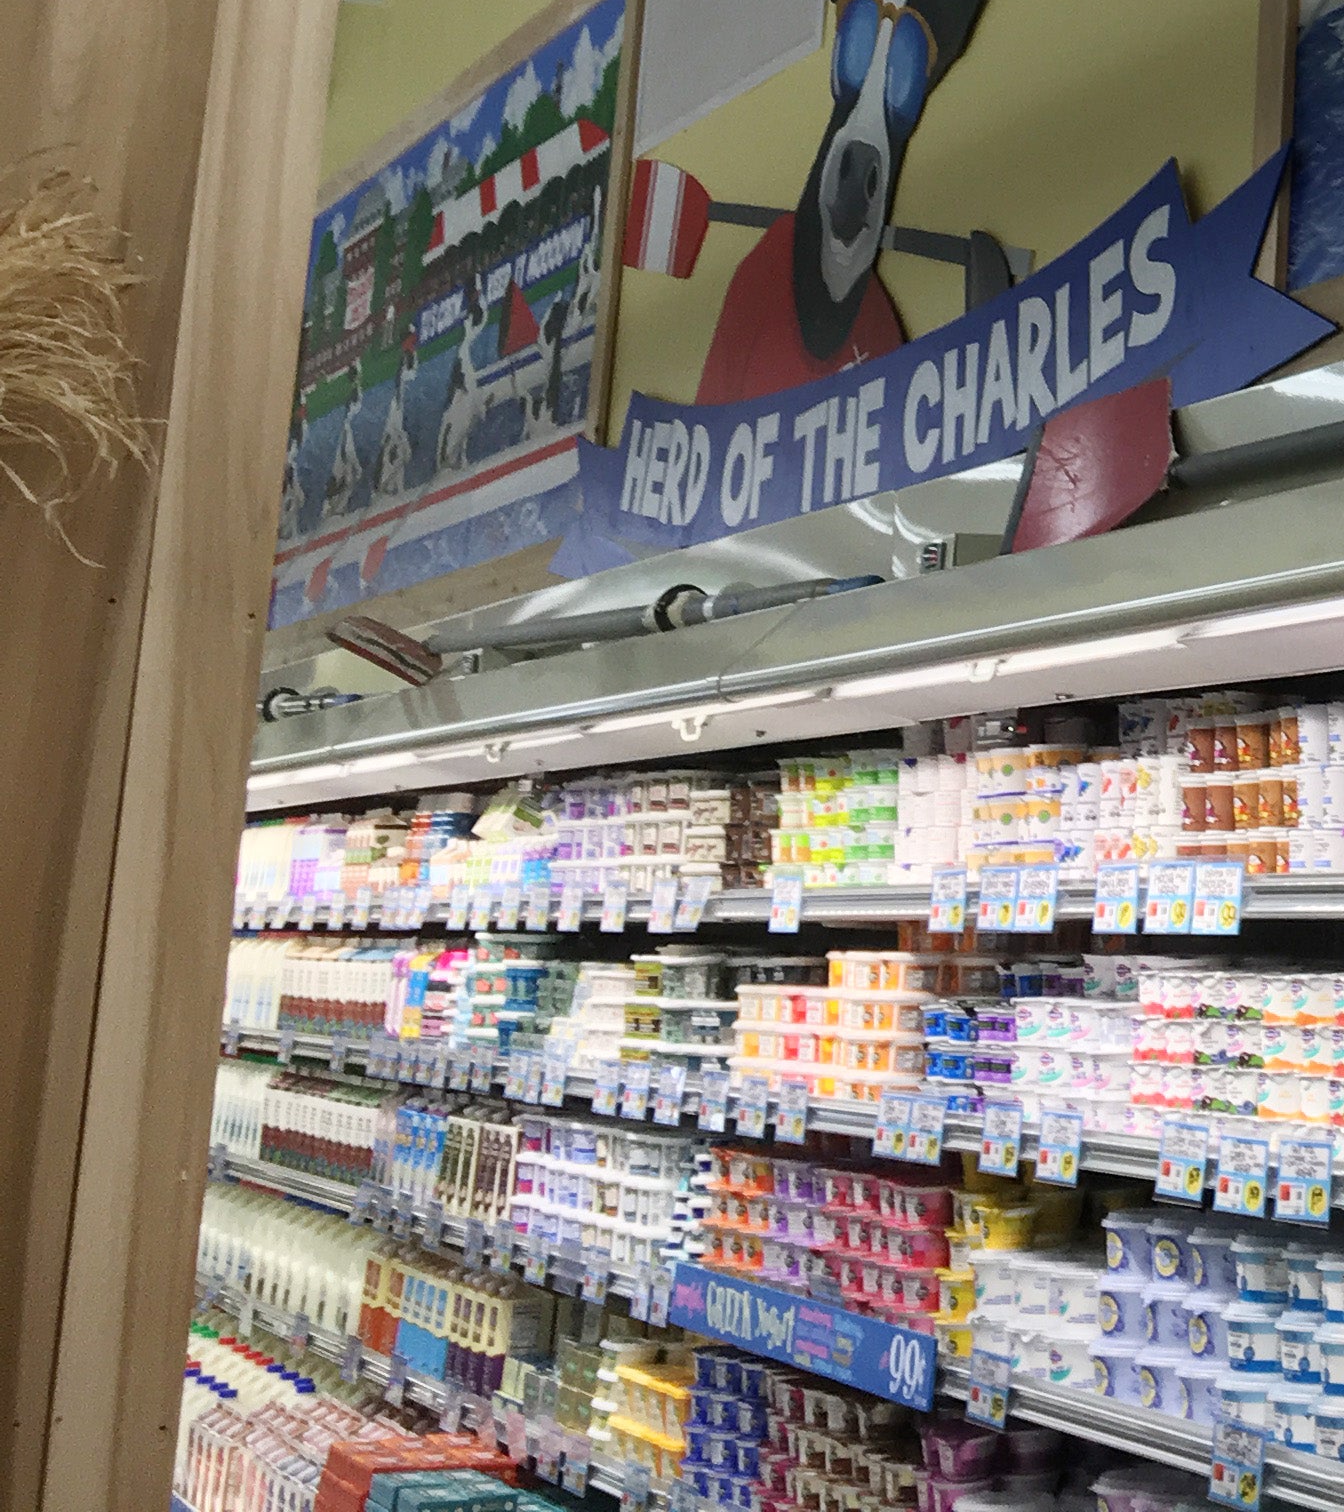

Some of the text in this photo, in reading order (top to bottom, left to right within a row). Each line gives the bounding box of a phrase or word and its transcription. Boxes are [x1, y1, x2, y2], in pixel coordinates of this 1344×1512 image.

[620, 202, 1178, 527] HERD OF THE CHARLES
